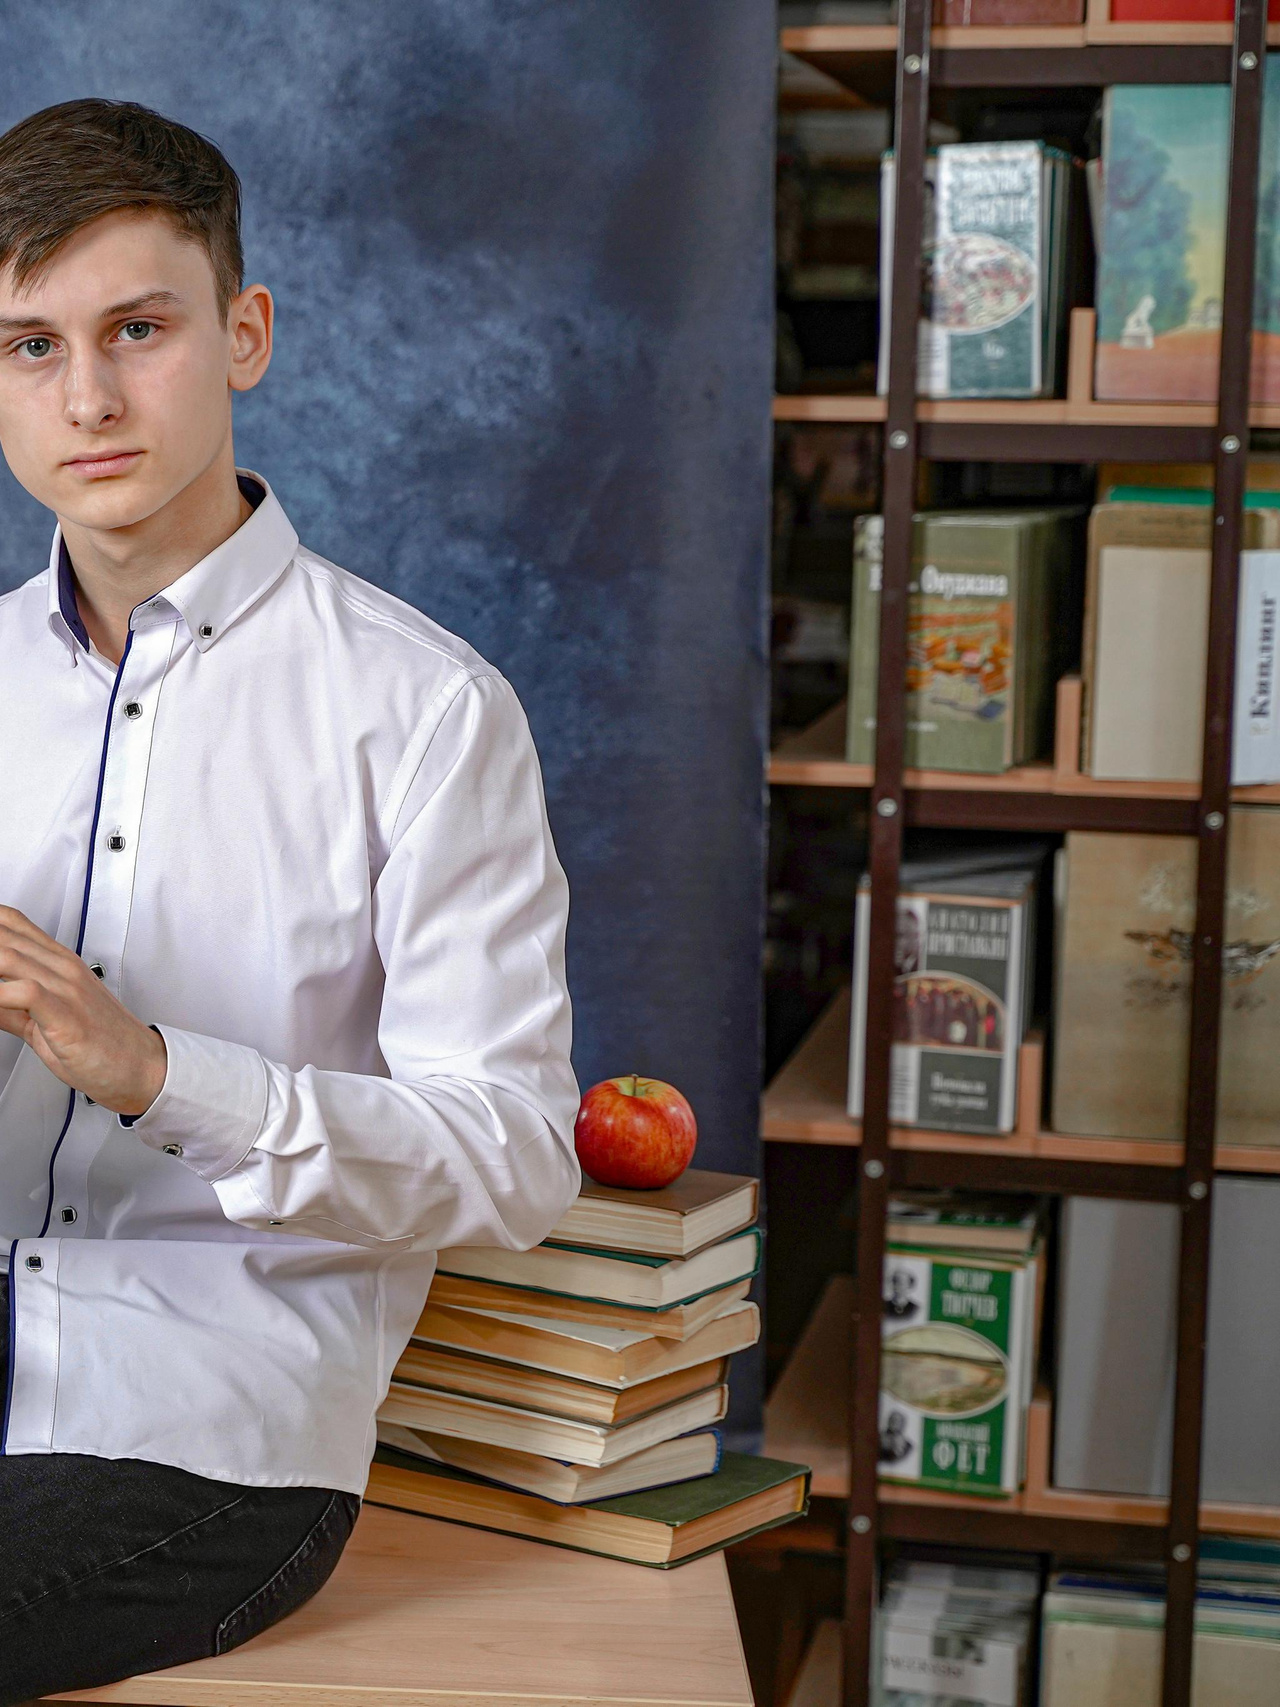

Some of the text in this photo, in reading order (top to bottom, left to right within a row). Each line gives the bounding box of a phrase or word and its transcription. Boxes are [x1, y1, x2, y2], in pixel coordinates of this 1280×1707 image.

[921, 564, 1008, 600] Окуджава
[1249, 592, 1277, 718] Киплинг
[932, 1441, 990, 1475] ФЕТ
